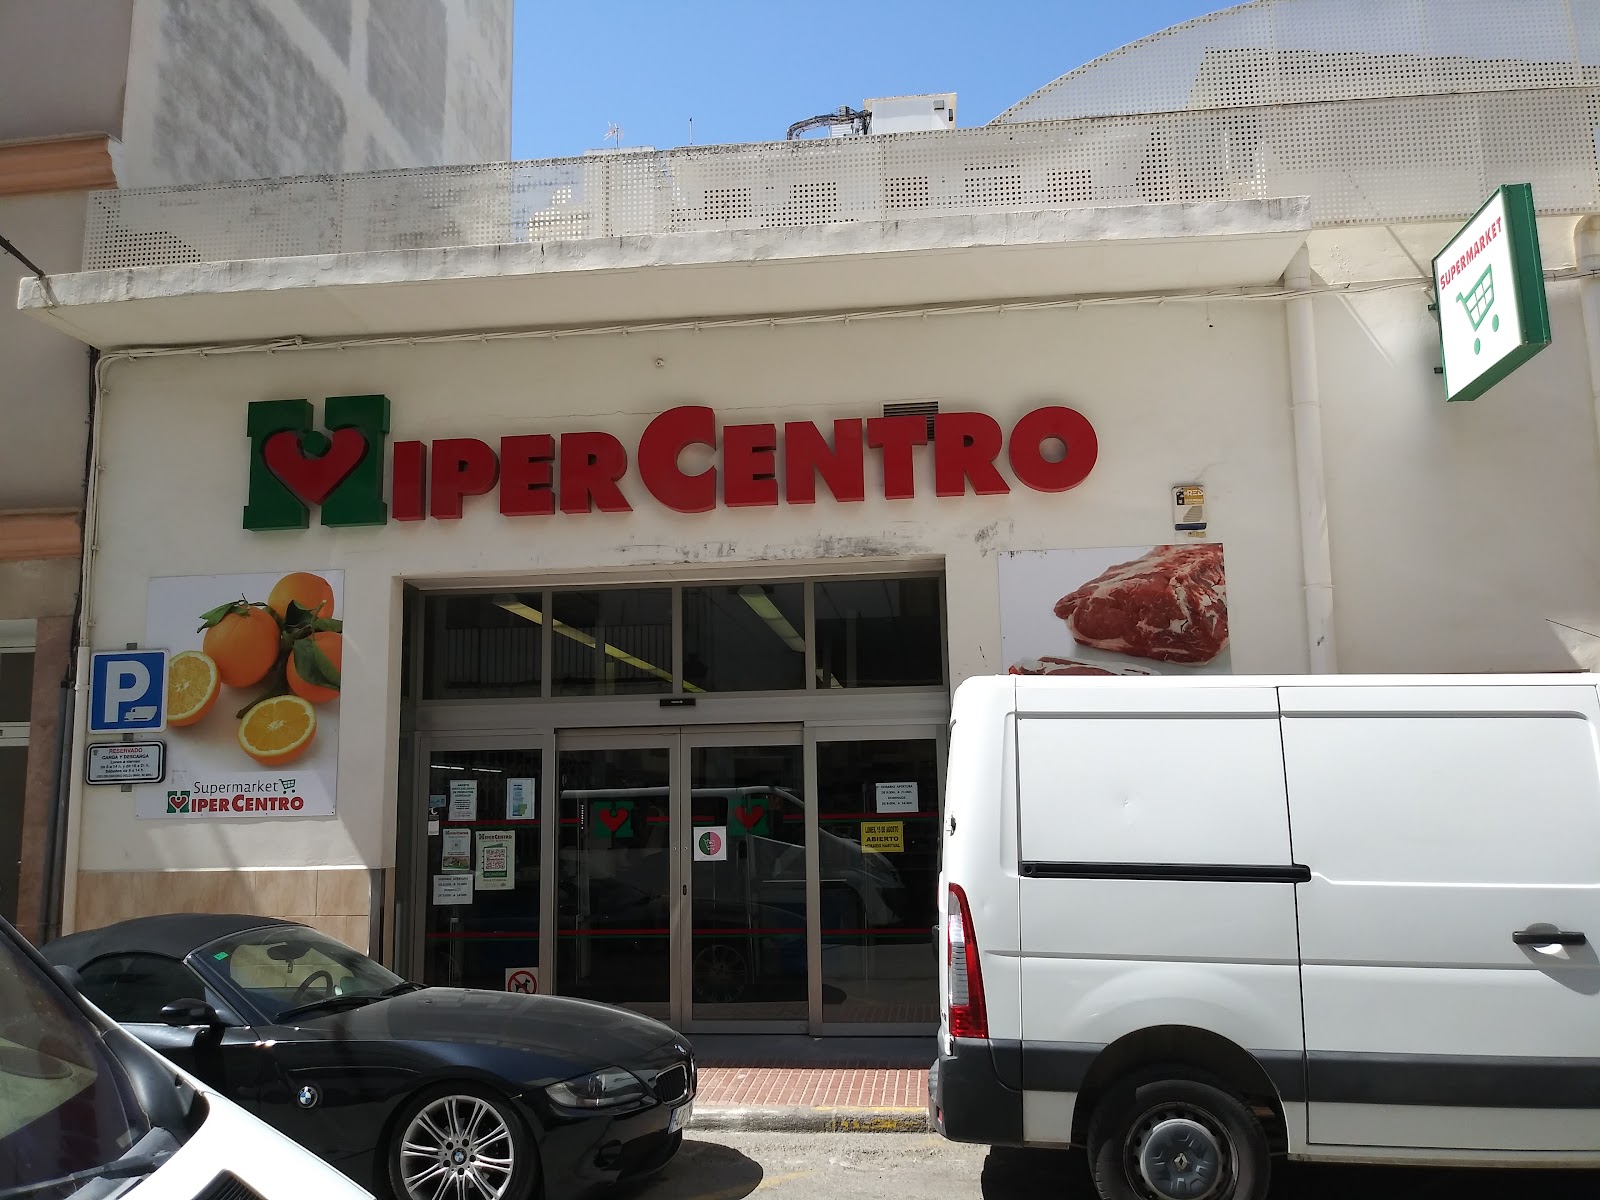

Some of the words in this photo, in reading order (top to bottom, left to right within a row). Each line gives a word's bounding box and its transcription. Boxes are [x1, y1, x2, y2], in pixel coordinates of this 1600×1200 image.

[1440, 216, 1502, 290] SUPERMARKET
[104, 660, 150, 722] P
[194, 780, 279, 796] Supermarket
